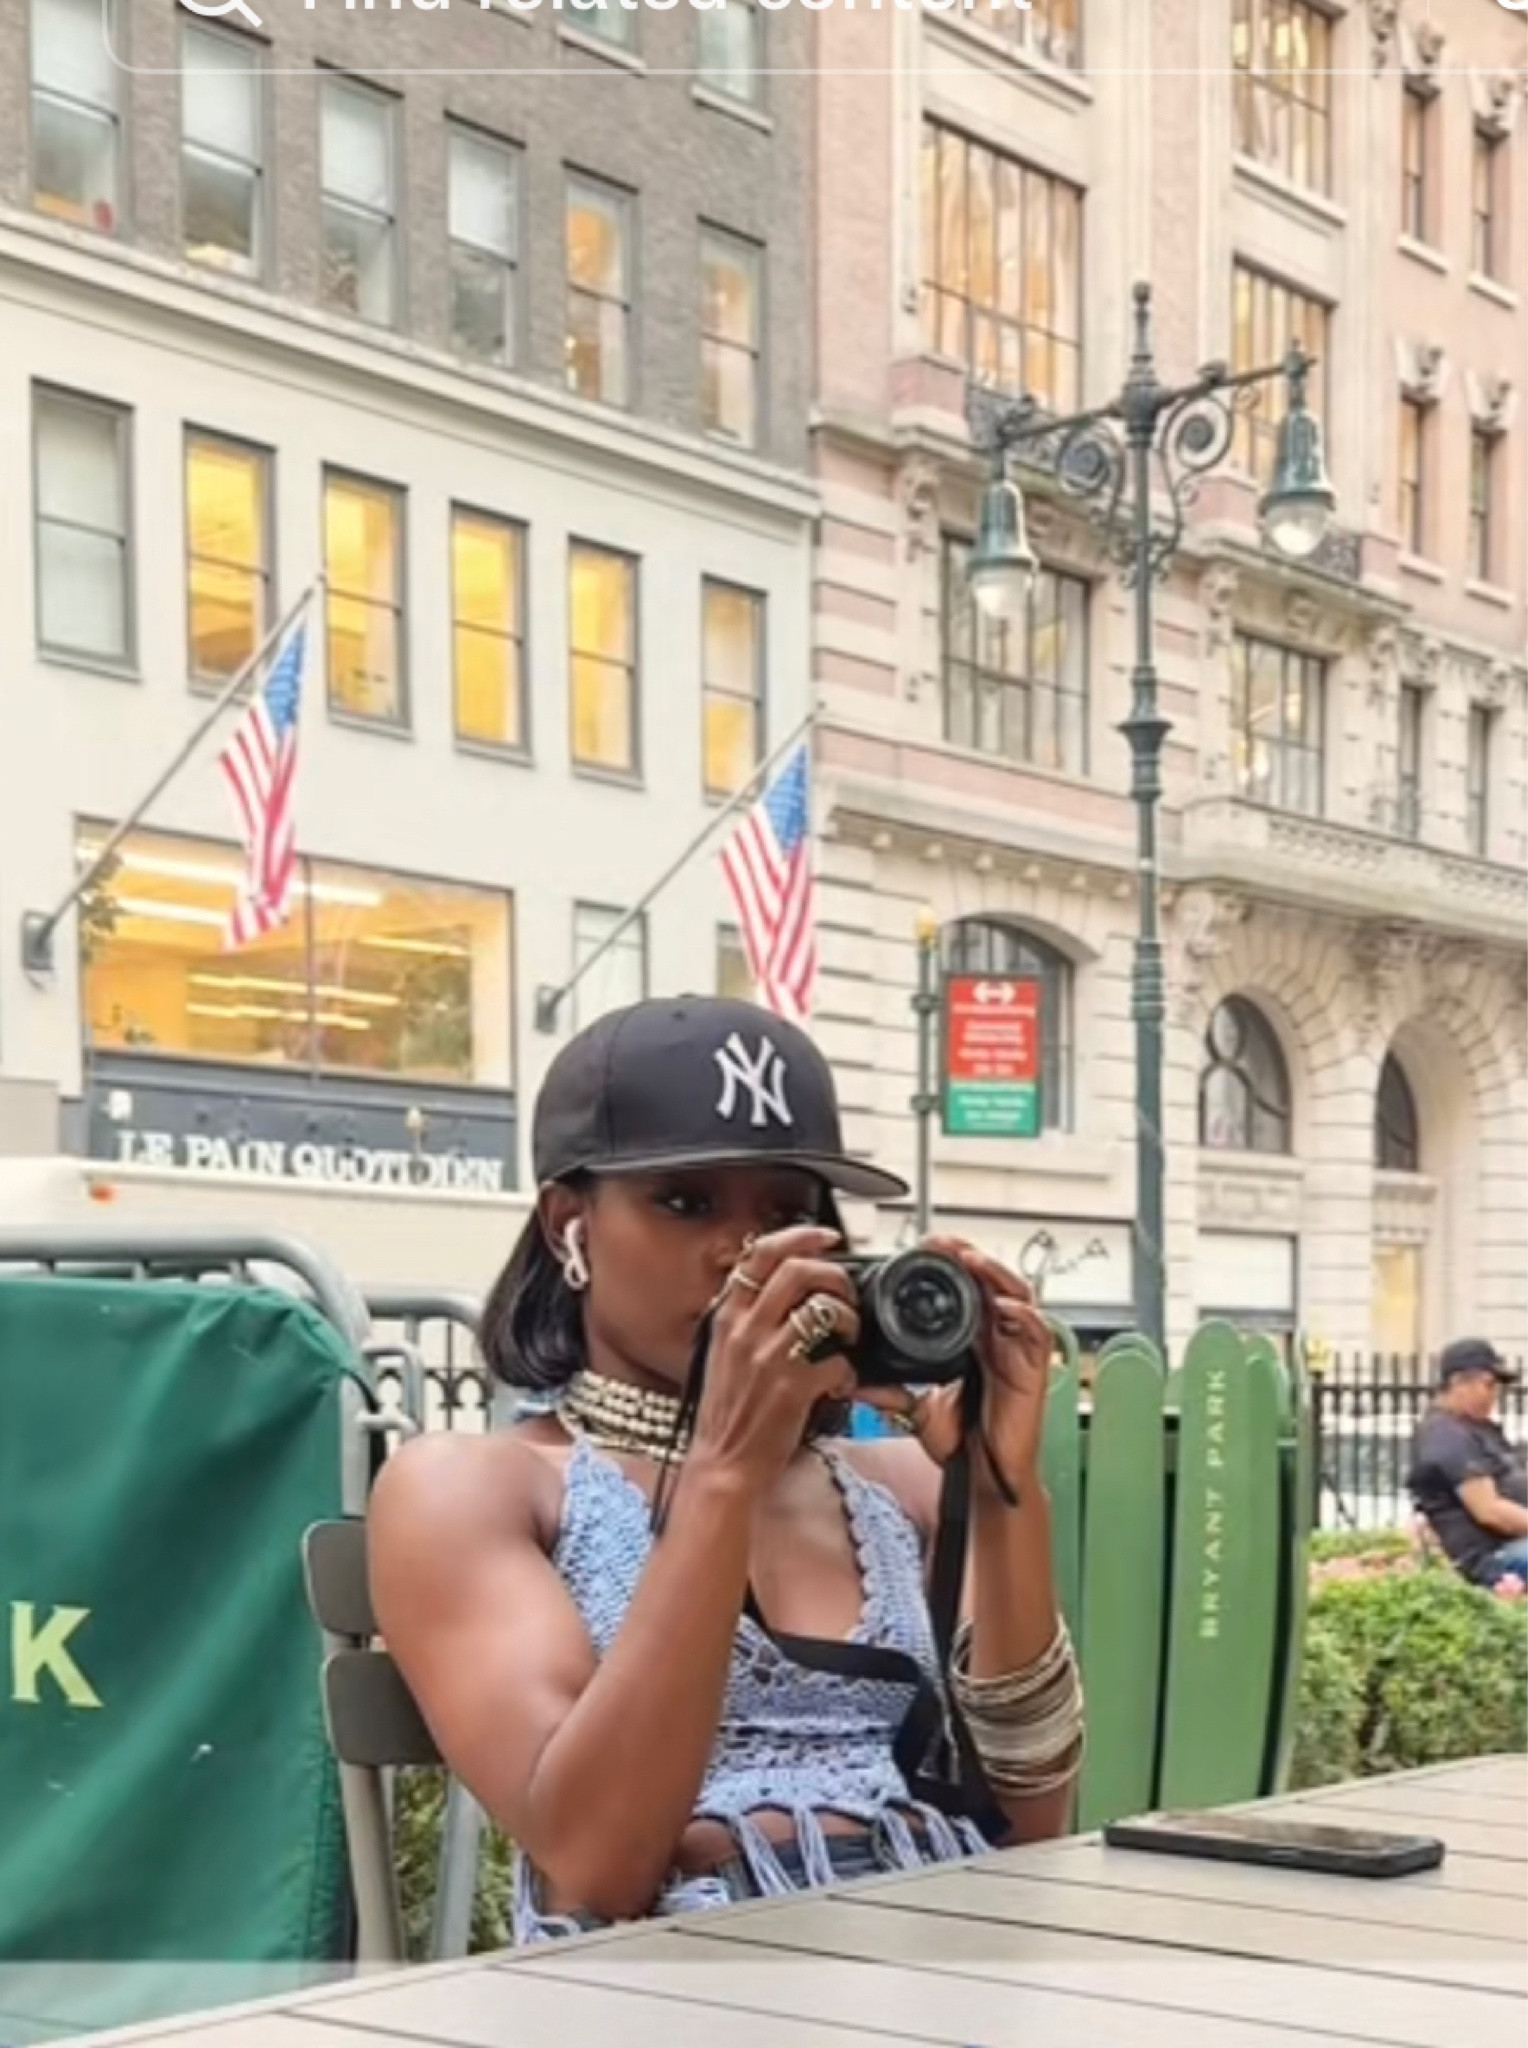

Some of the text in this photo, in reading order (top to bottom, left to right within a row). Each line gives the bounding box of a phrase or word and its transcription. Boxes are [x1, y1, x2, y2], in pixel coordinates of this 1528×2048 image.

[713, 1031, 794, 1127] NY
[117, 1129, 502, 1191] LE PAIN QUOTIDIEN
[1199, 1370, 1227, 1639] BRYANT PARK
